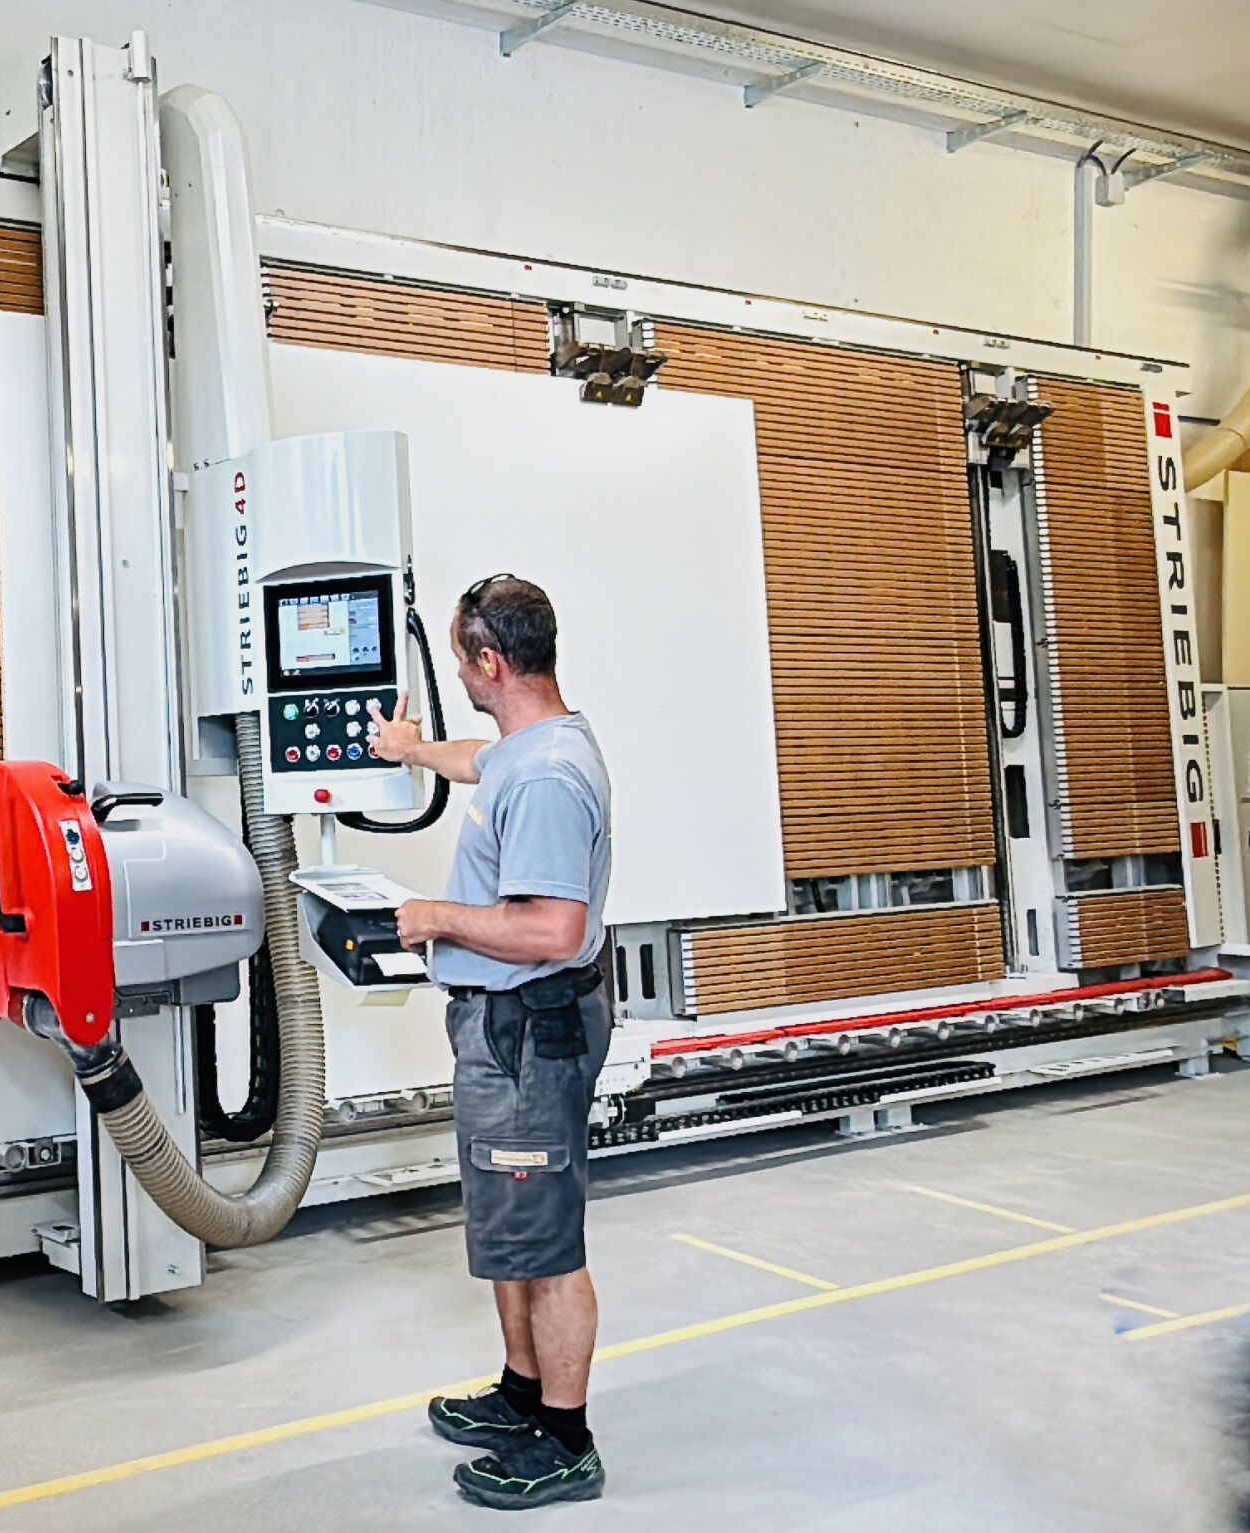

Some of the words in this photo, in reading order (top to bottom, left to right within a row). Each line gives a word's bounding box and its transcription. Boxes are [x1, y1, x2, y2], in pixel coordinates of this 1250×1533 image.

[234, 472, 246, 515] 4D
[235, 525, 253, 695] STRIEBIG
[1157, 455, 1204, 803] STRIEBIG
[152, 915, 232, 932] STRIEBIG
